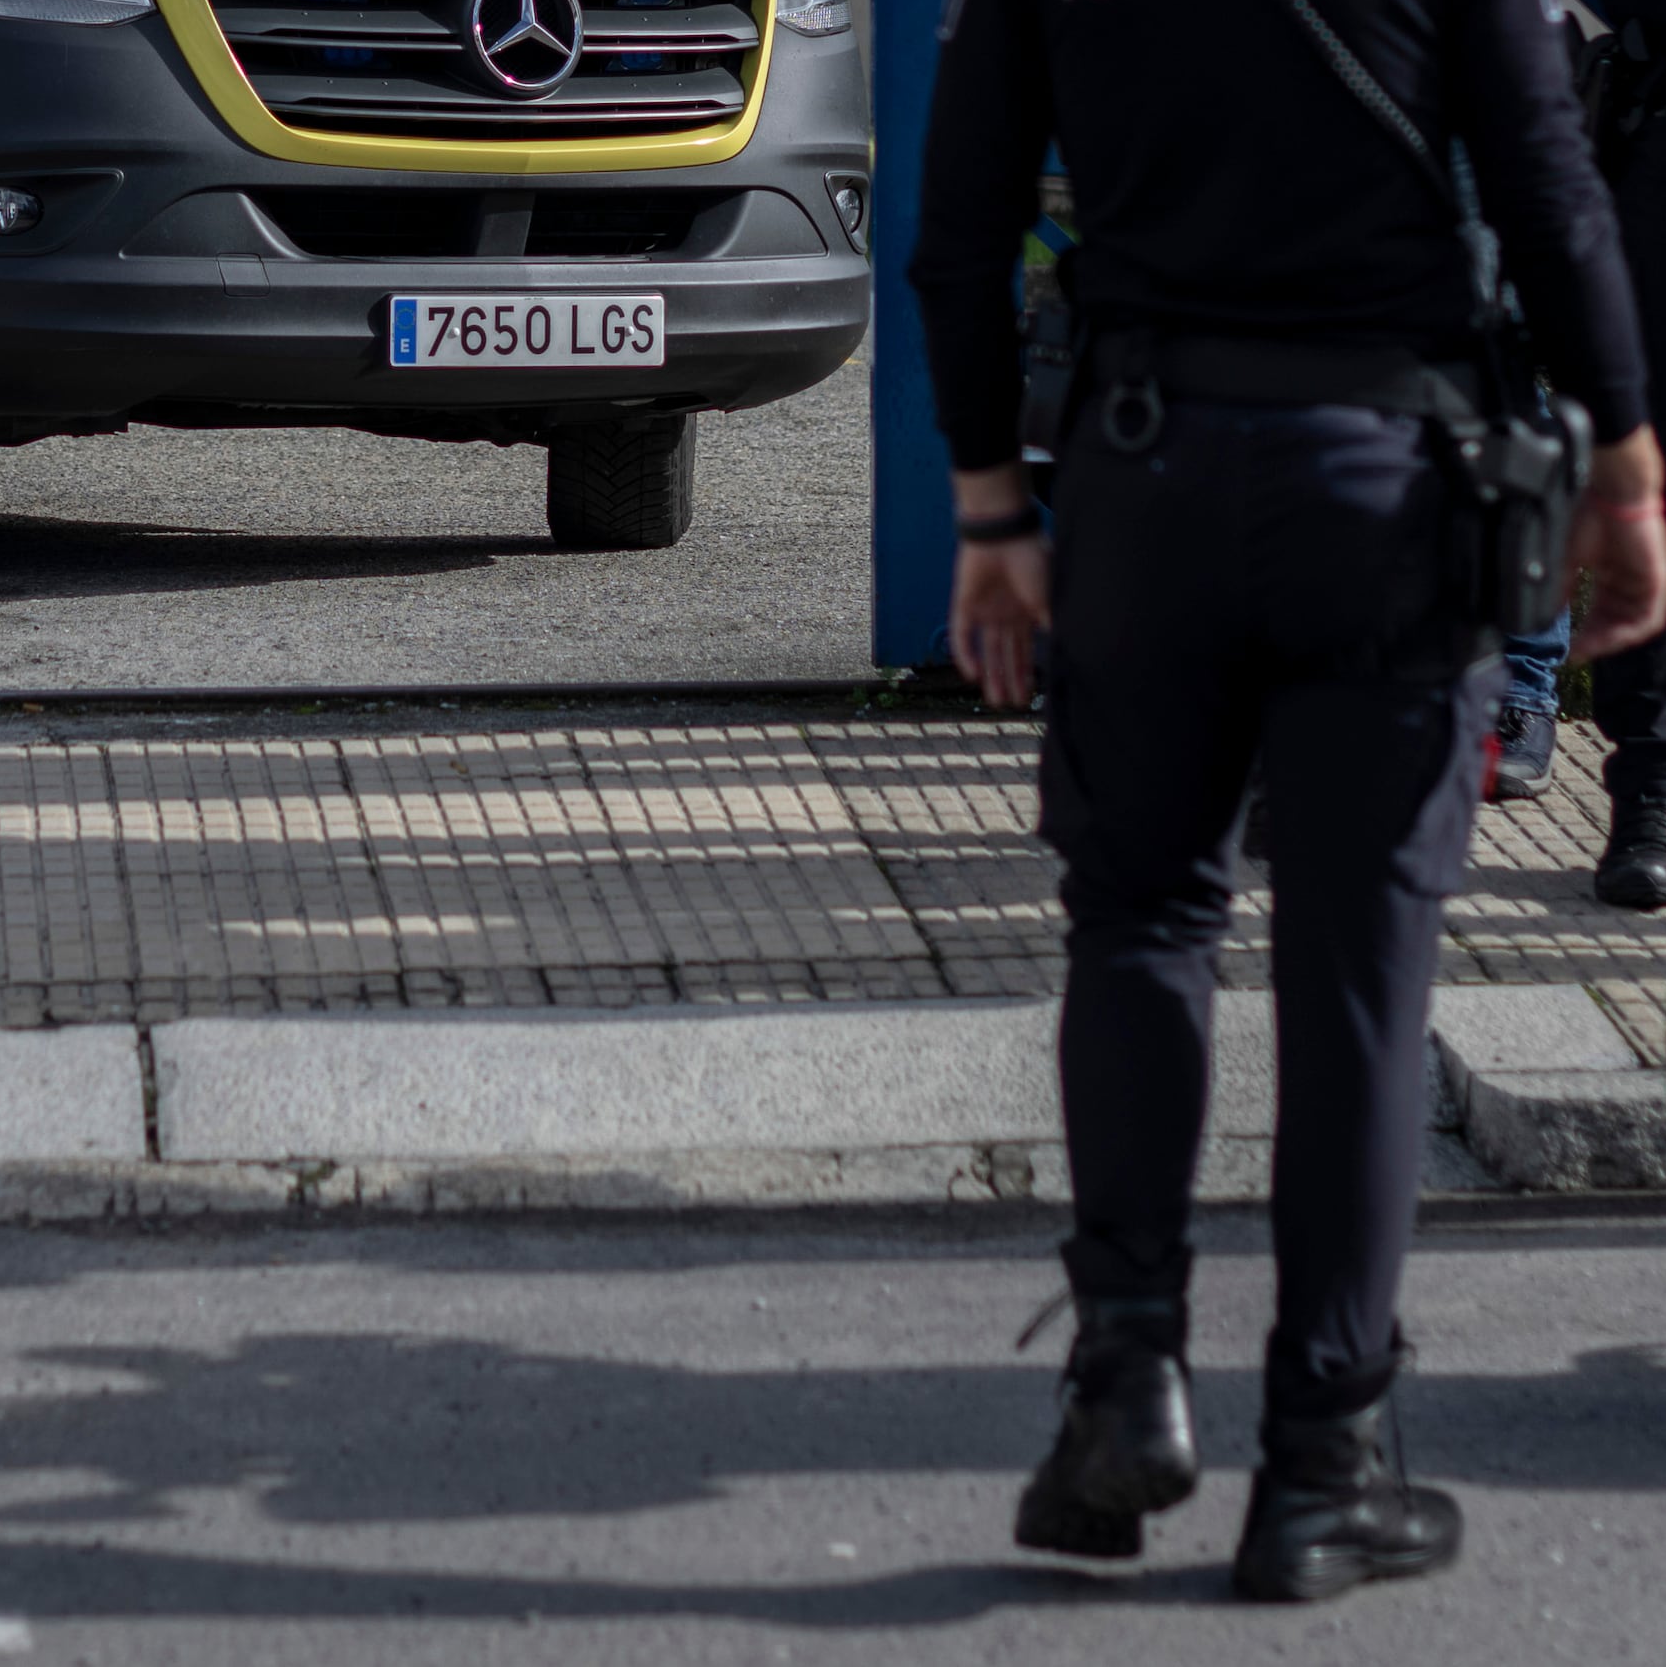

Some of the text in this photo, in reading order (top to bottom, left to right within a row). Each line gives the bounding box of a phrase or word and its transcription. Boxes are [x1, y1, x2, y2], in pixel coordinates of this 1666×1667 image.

[400, 304, 654, 357] E 7650 LGS
